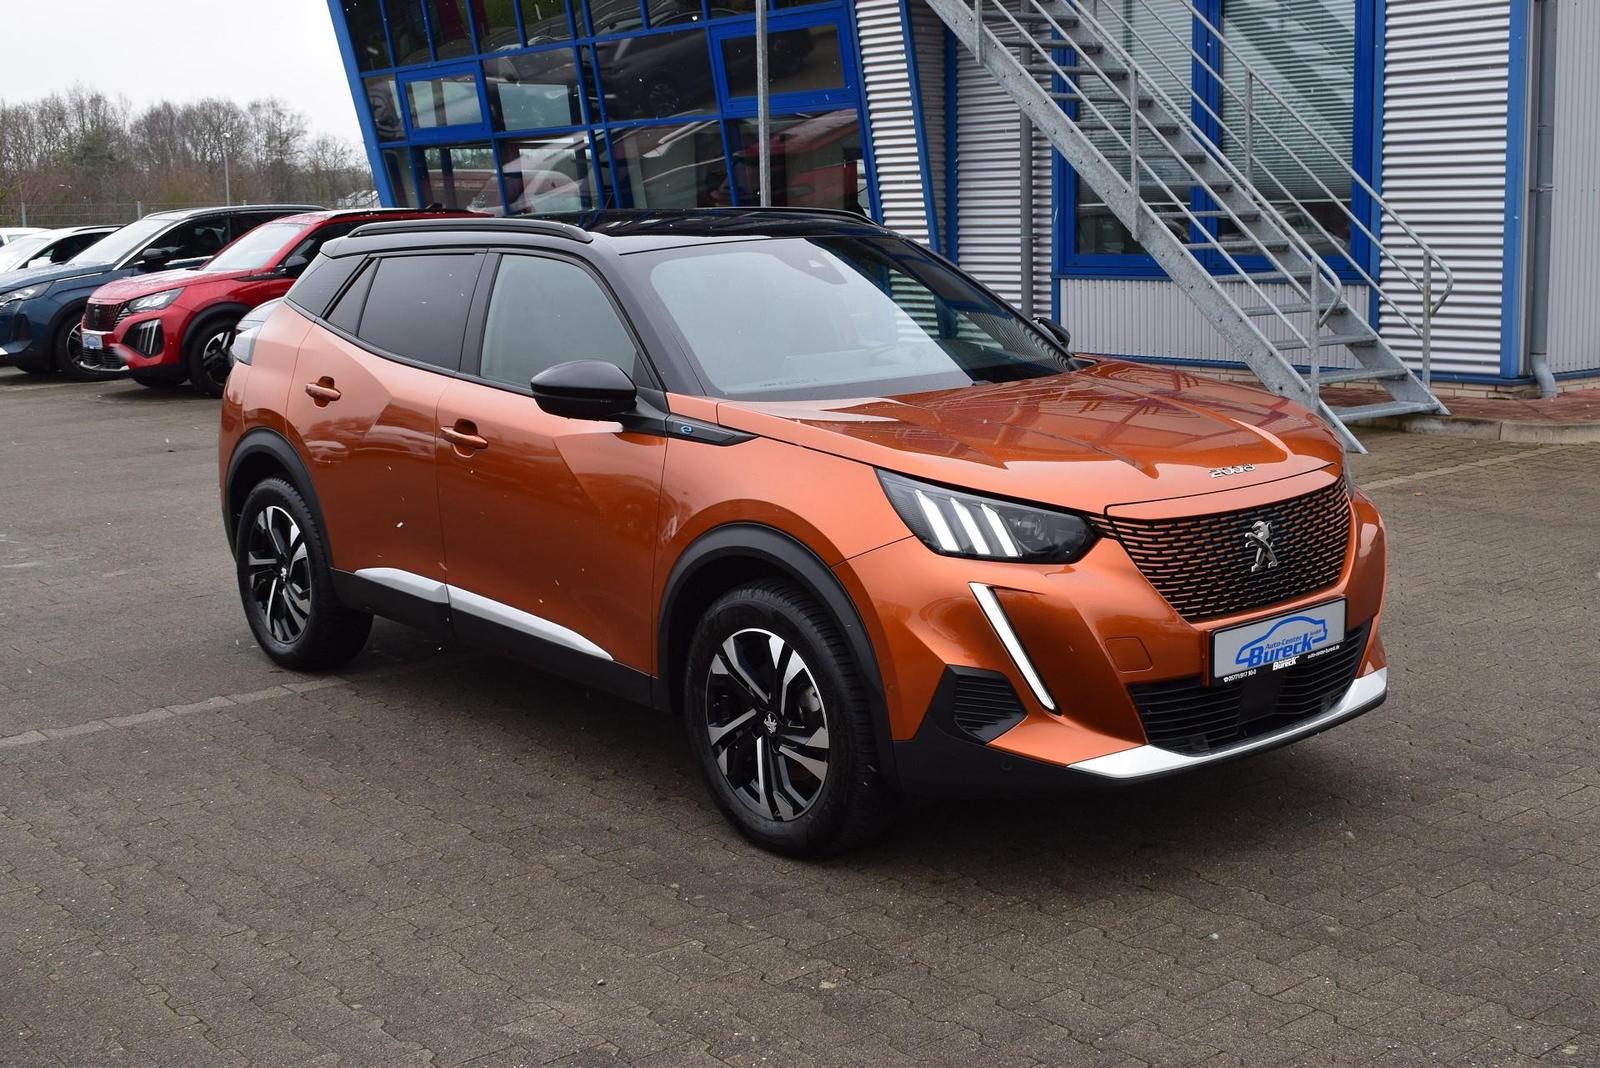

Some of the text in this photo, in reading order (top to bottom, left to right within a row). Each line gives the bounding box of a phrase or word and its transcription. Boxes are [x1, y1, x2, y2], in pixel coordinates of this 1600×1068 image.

[1209, 463, 1256, 478] 2008
[1247, 632, 1313, 668] Bureck
[1265, 635, 1303, 650] Auto-Center
